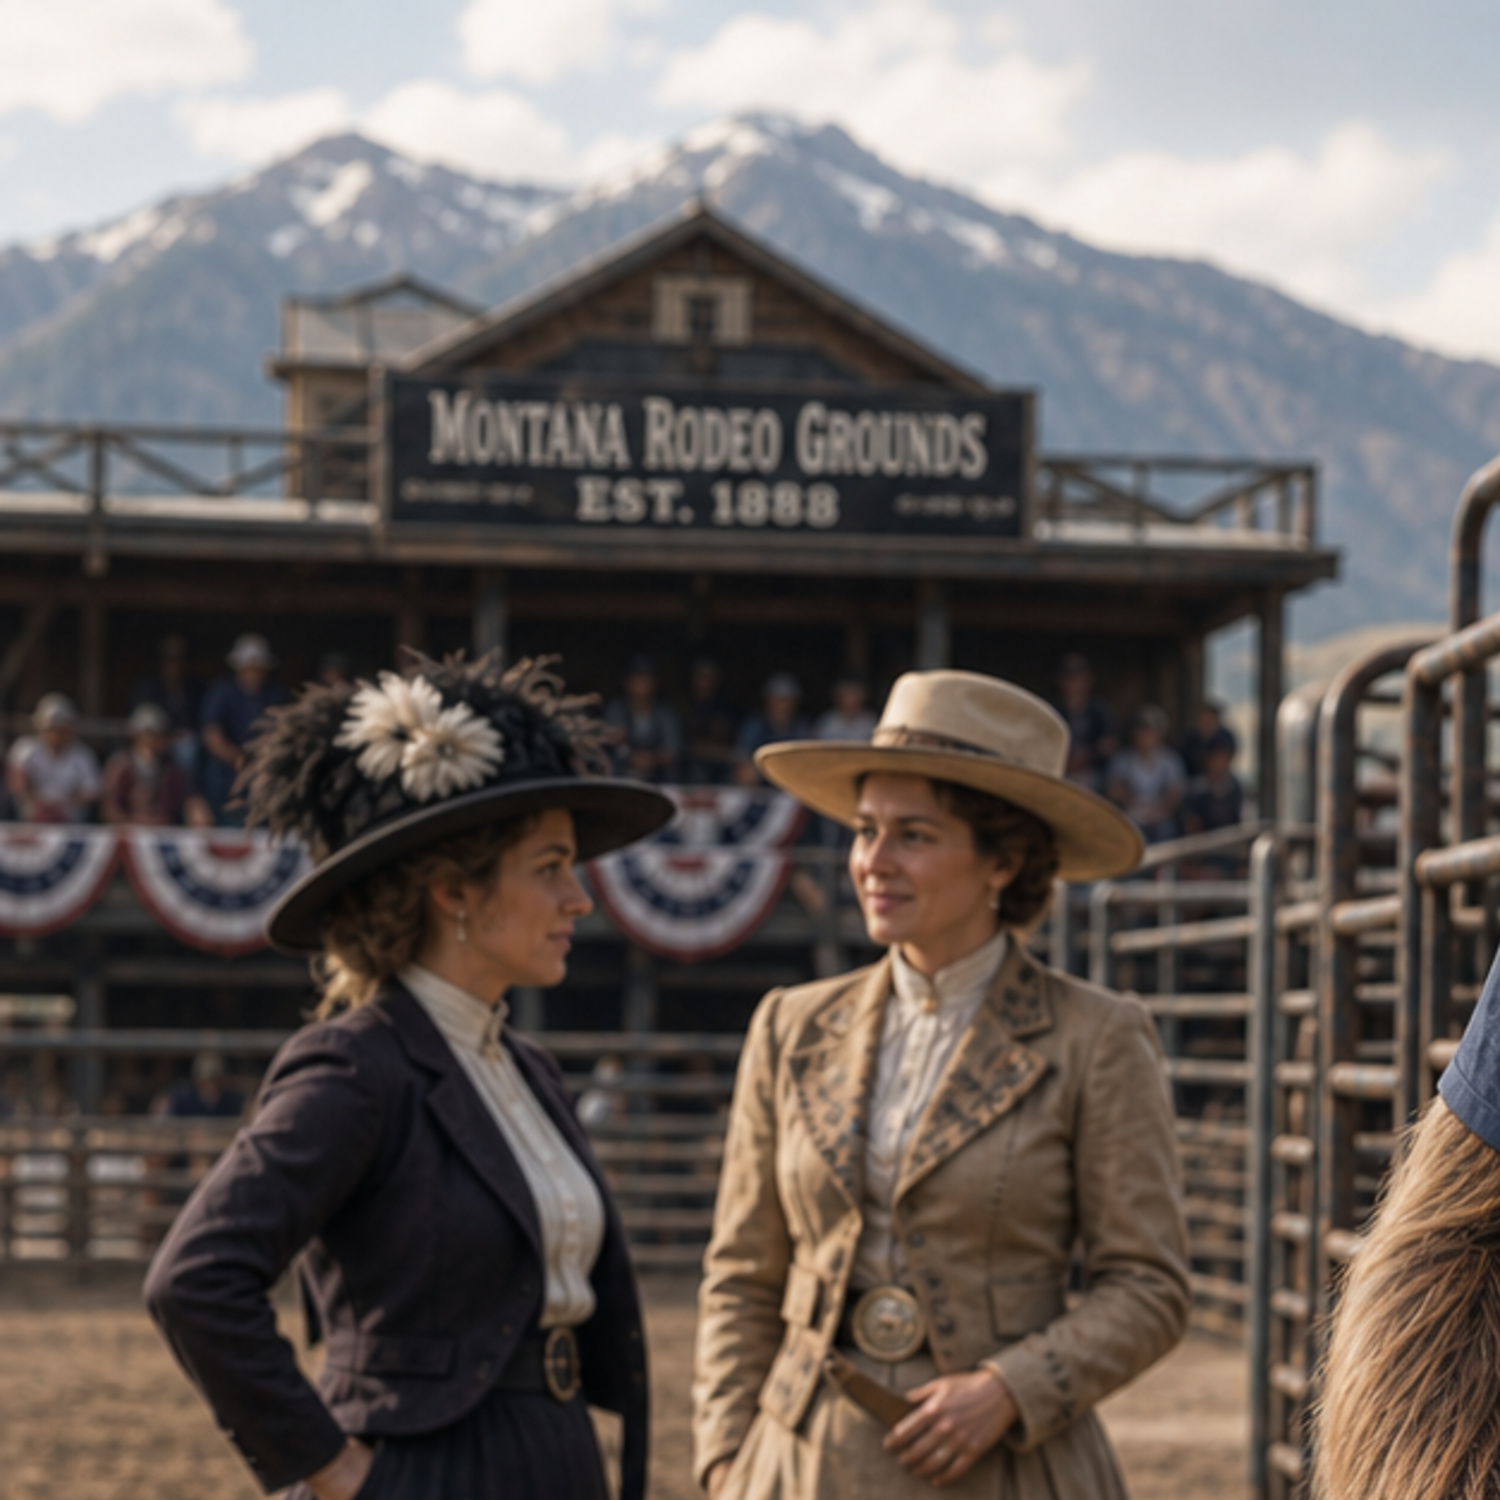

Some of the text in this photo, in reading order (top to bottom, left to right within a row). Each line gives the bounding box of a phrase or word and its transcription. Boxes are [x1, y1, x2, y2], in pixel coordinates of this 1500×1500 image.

[427, 390, 988, 480] MONTANA RODEO GROUNDS
[575, 474, 694, 524] EST.
